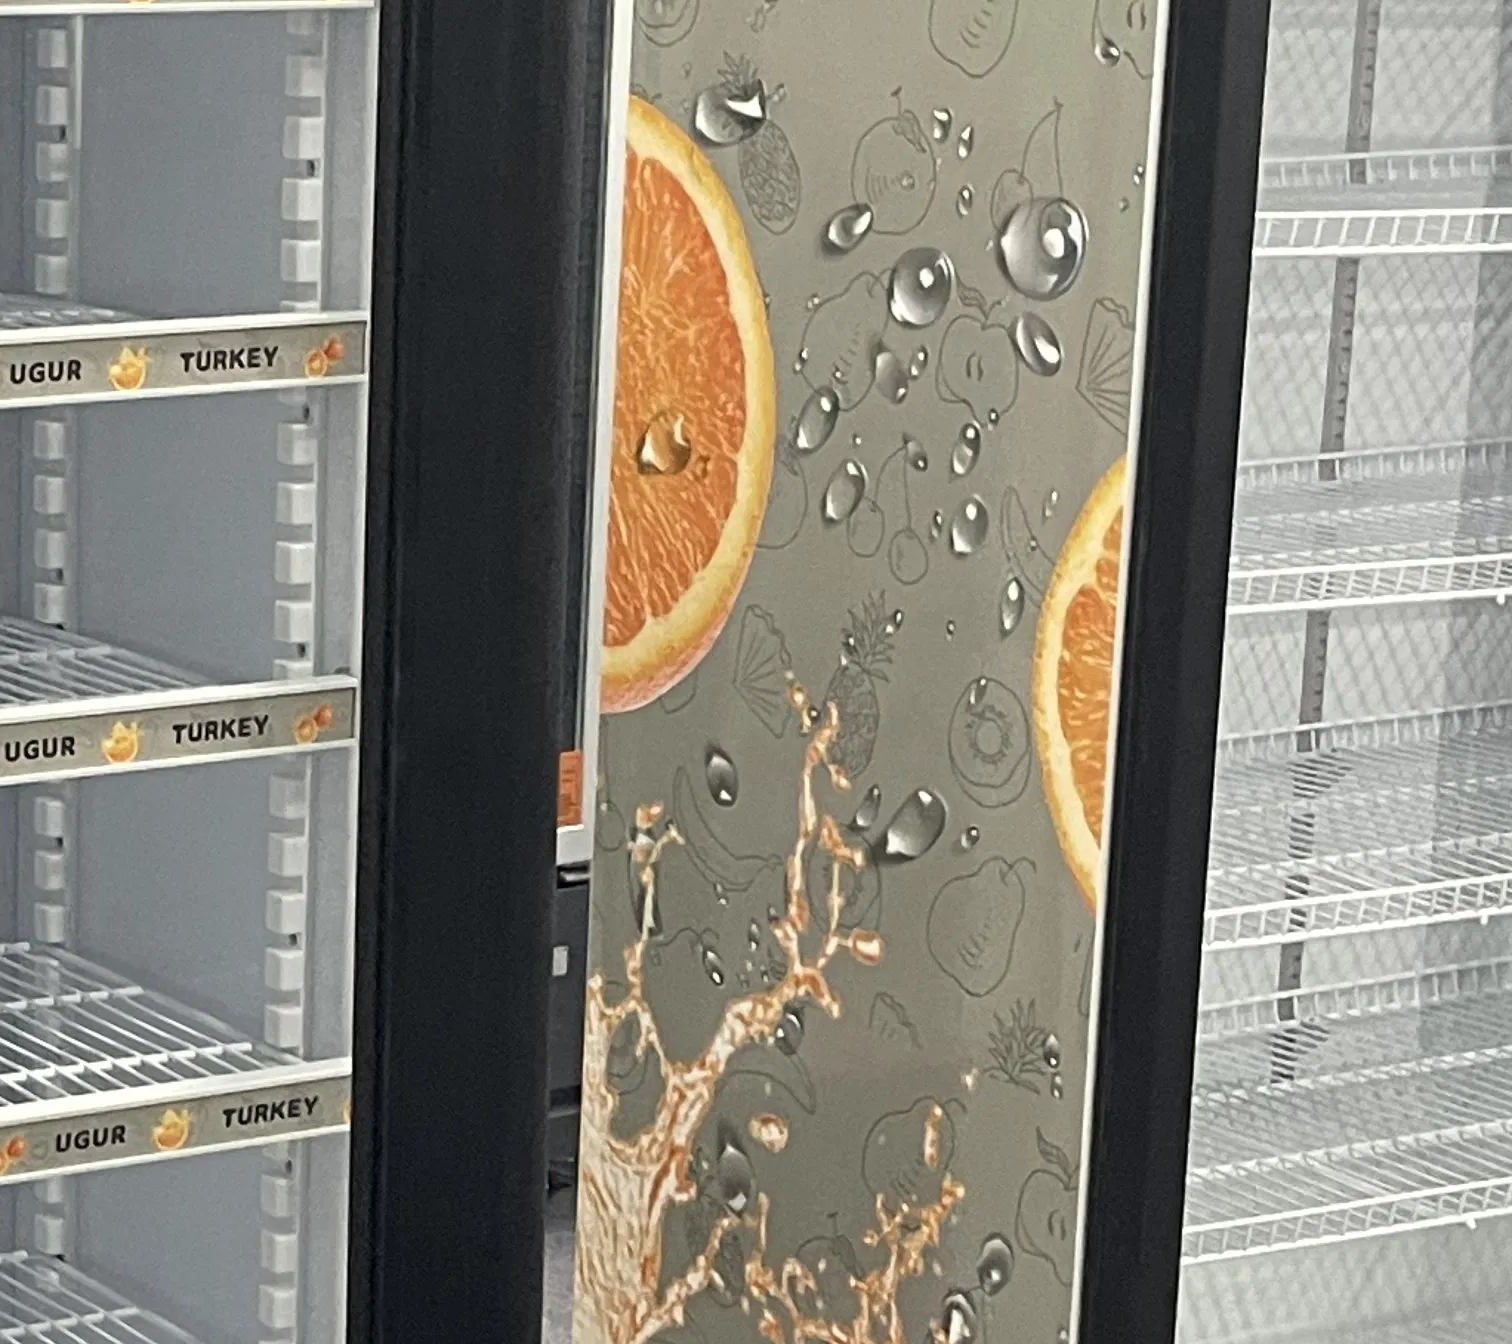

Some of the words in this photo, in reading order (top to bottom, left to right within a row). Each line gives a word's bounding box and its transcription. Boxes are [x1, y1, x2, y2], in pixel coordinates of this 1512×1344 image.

[9, 359, 83, 385] UGUR
[179, 345, 279, 373] TURKEY
[4, 735, 76, 763] UGUR
[172, 714, 270, 745] TURKEY
[55, 1124, 126, 1154] UGUR
[222, 1095, 319, 1129] TURKEY
